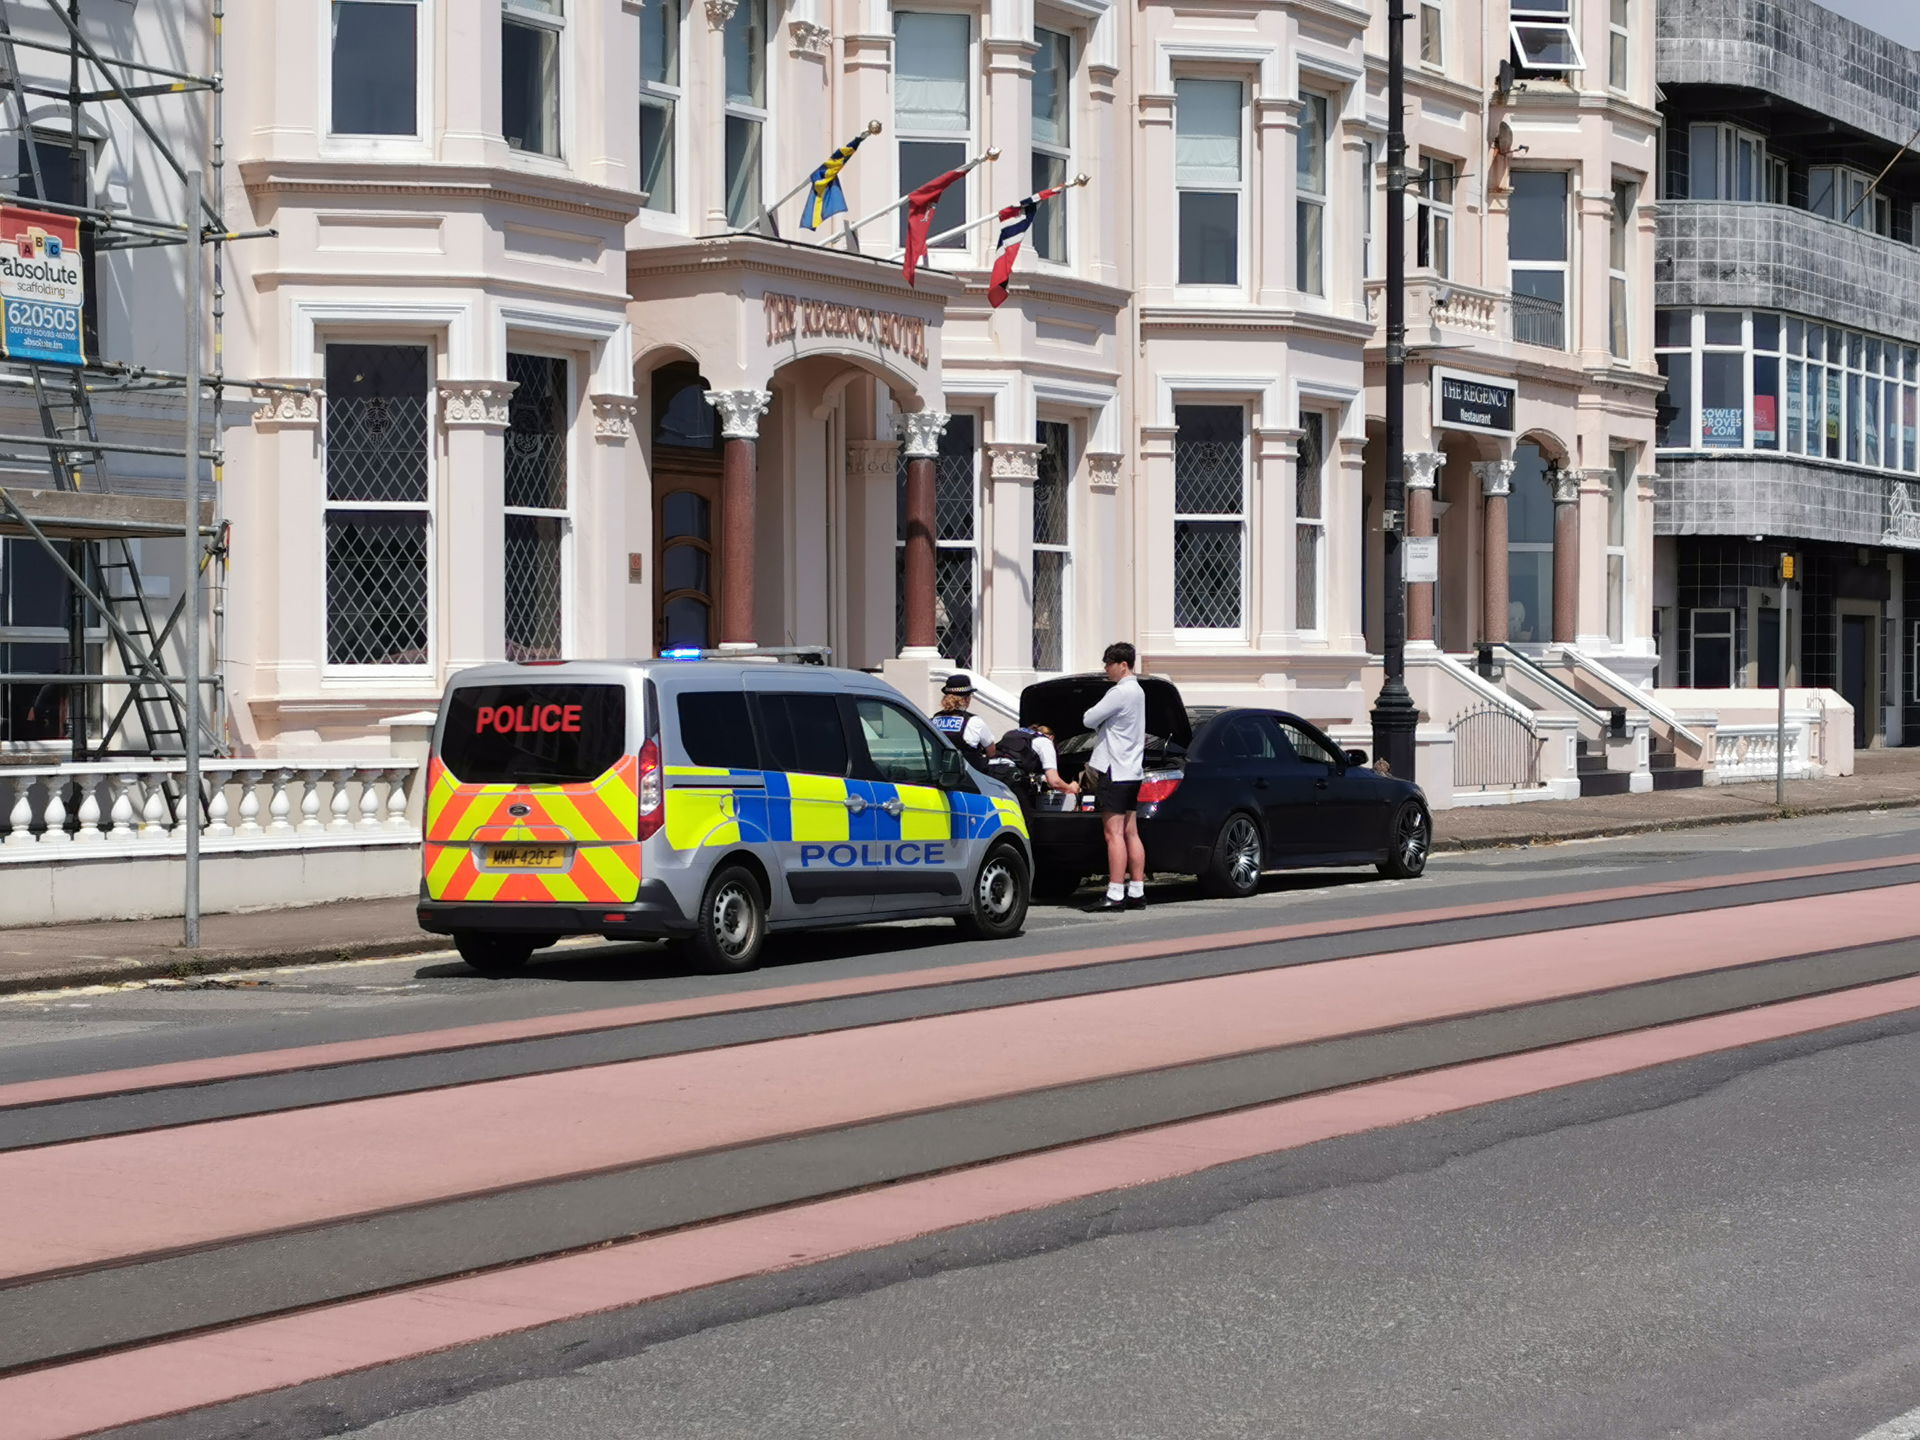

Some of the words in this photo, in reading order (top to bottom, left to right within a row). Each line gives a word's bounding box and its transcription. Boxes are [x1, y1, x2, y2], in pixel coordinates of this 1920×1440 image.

[3, 257, 77, 285] absolute
[17, 281, 65, 299] scaffolding
[8, 302, 76, 331] 620505
[763, 291, 796, 345] THE
[801, 298, 874, 341] REGENCY
[878, 311, 928, 368] HOTEL
[1442, 381, 1461, 399] THE
[1464, 384, 1509, 407] REGENCY
[1460, 408, 1491, 424] Restaurant
[476, 704, 583, 734] POLICE
[933, 717, 961, 728] POLICE
[801, 843, 945, 867] POLICE
